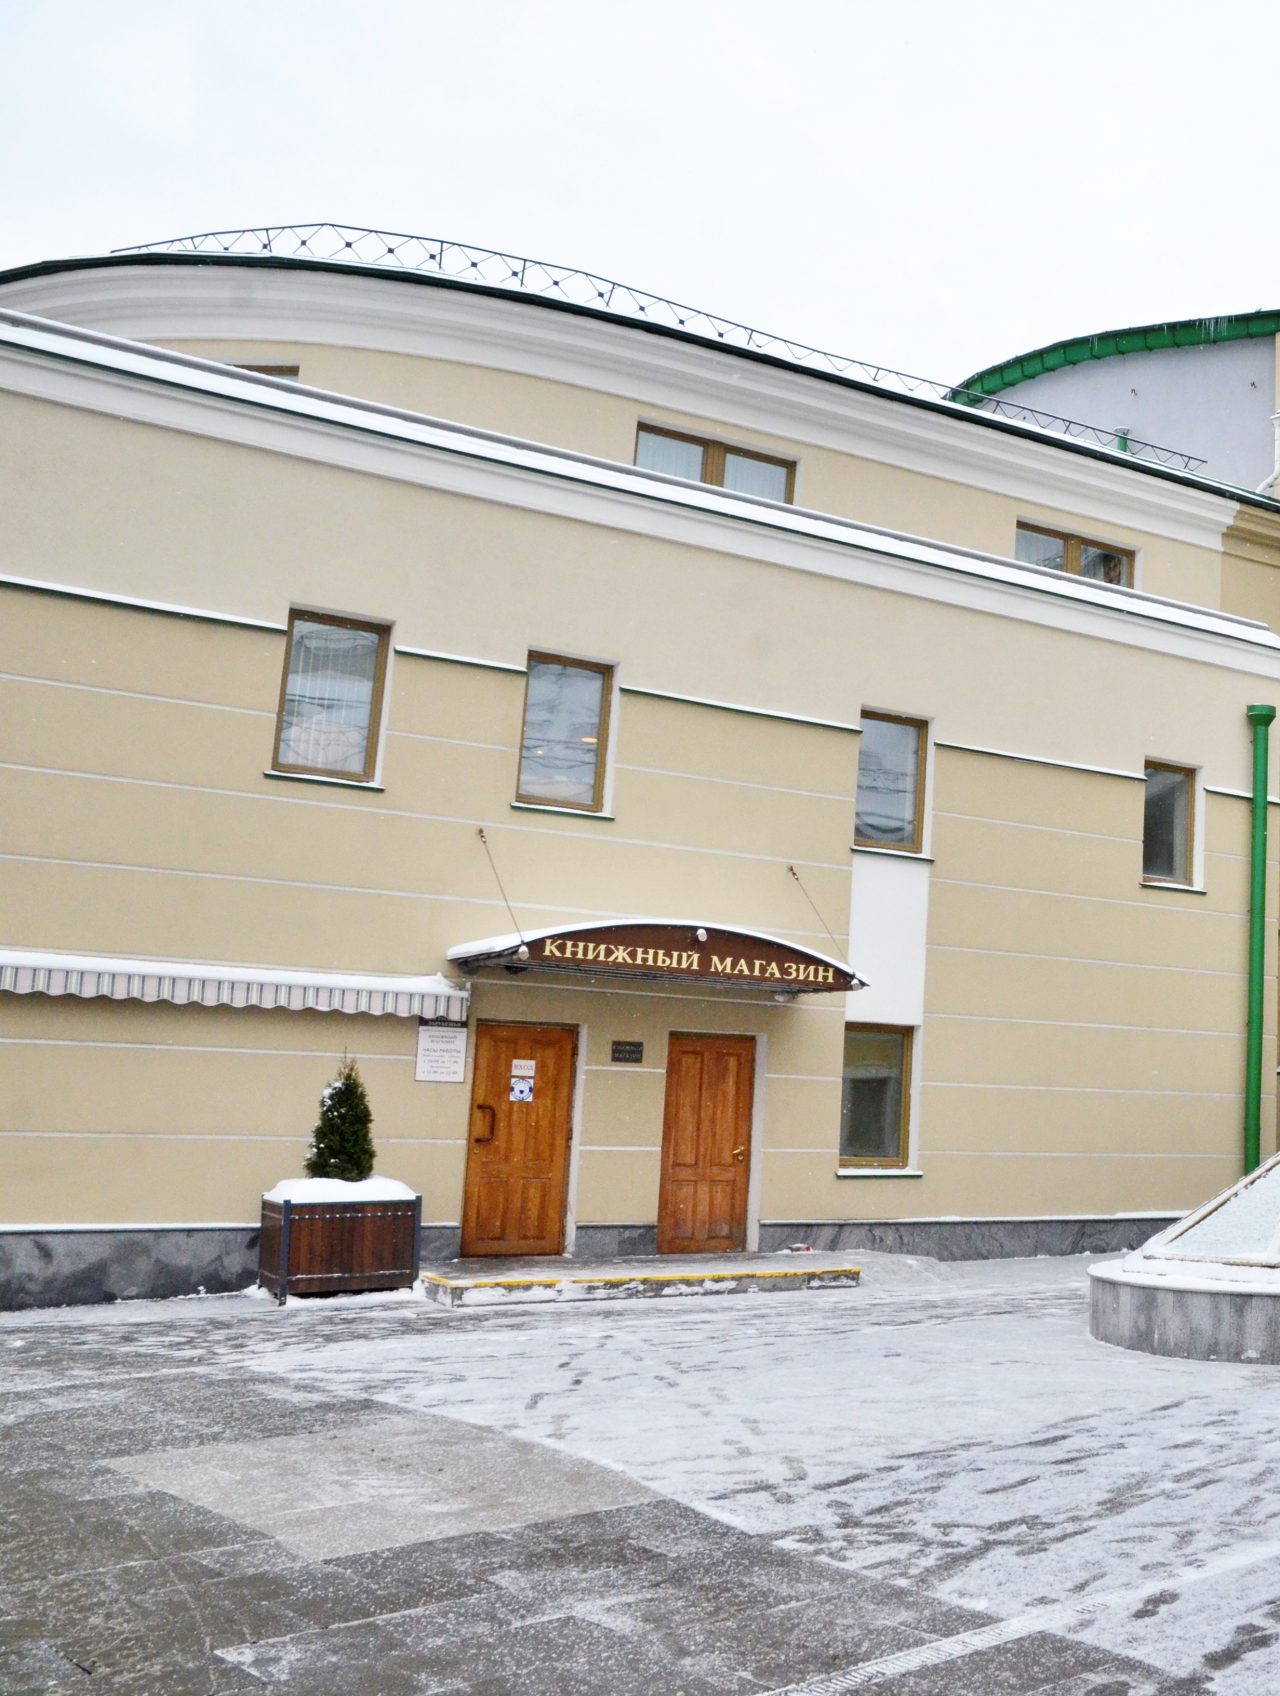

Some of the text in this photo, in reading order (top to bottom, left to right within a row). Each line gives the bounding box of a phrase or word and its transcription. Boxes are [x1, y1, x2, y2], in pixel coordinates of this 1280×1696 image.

[542, 938, 835, 983] КНИЖНЫЙ МАГАЗИН
[513, 1063, 533, 1071] ВХОД
